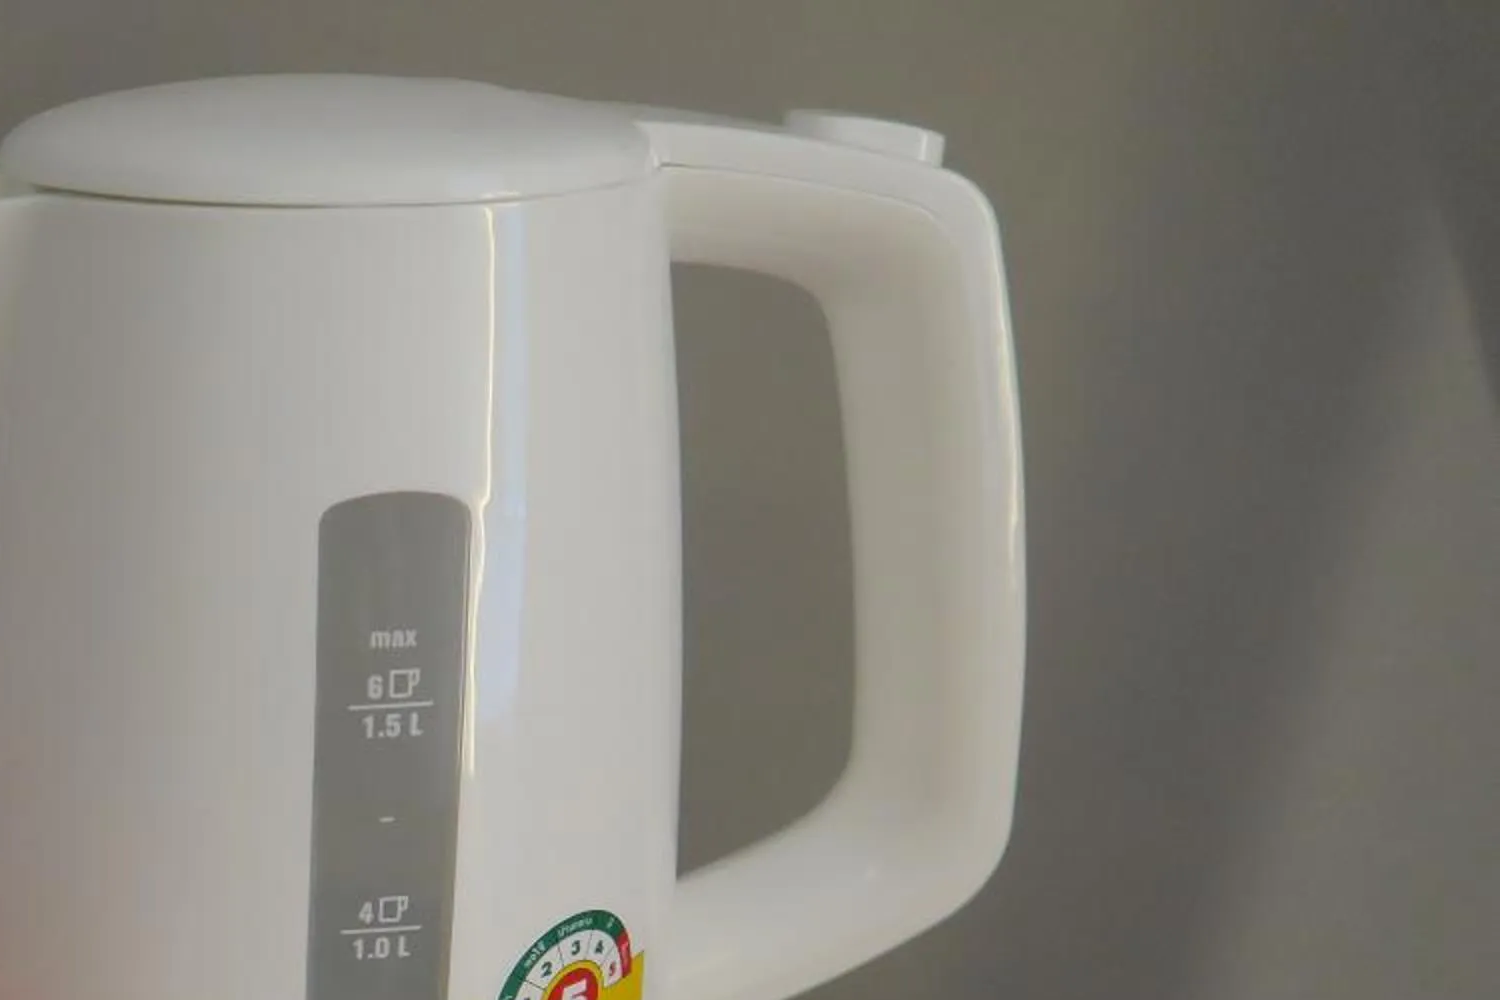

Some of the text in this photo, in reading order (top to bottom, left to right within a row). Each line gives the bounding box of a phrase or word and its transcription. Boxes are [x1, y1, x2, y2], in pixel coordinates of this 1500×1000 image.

[369, 628, 418, 650] max
[367, 675, 384, 700] 6
[362, 712, 425, 739] 1.5 L
[358, 901, 375, 925] 4
[352, 936, 411, 960] 1.0 L
[571, 940, 581, 956] 3
[541, 961, 553, 979] 2
